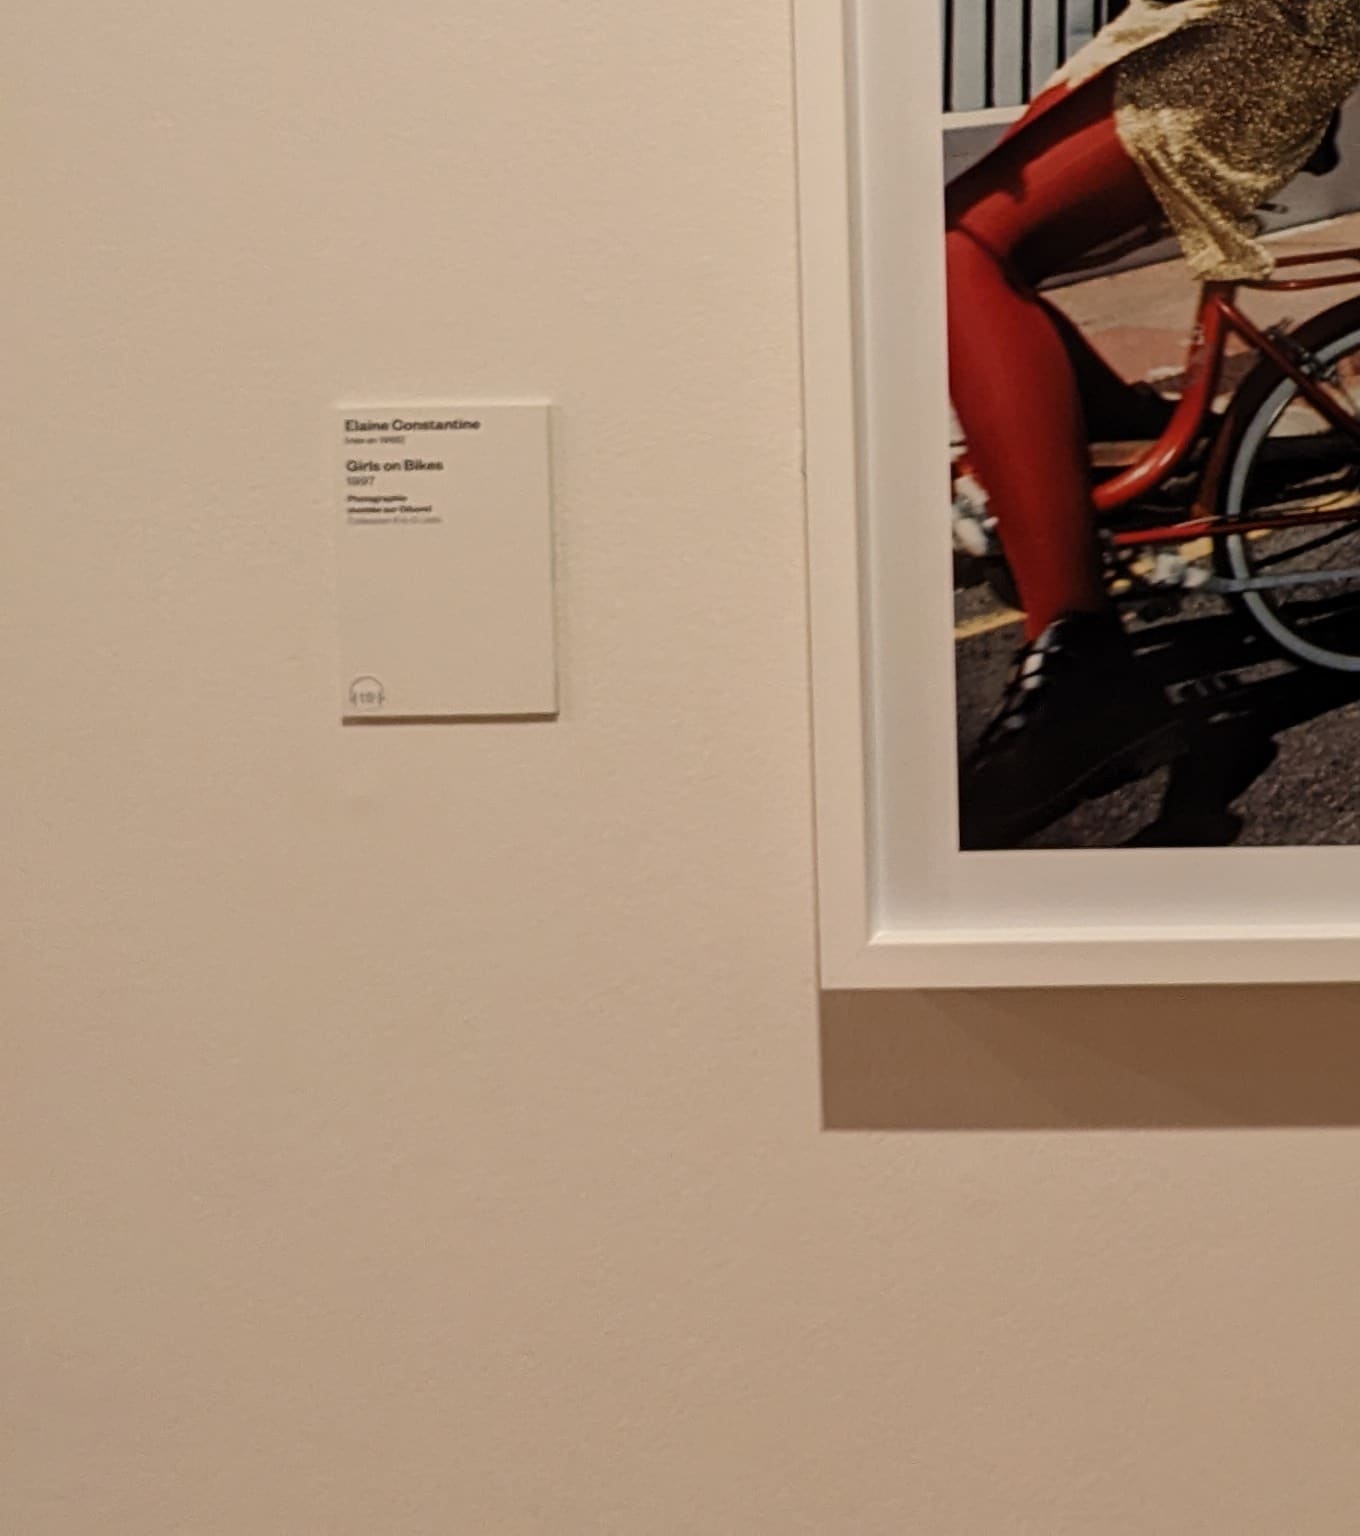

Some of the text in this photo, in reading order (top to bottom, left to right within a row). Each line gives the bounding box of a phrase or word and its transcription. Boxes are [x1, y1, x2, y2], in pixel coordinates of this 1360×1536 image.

[345, 418, 480, 432] Elaine Constantine
[346, 458, 444, 472] Girls on Bikes
